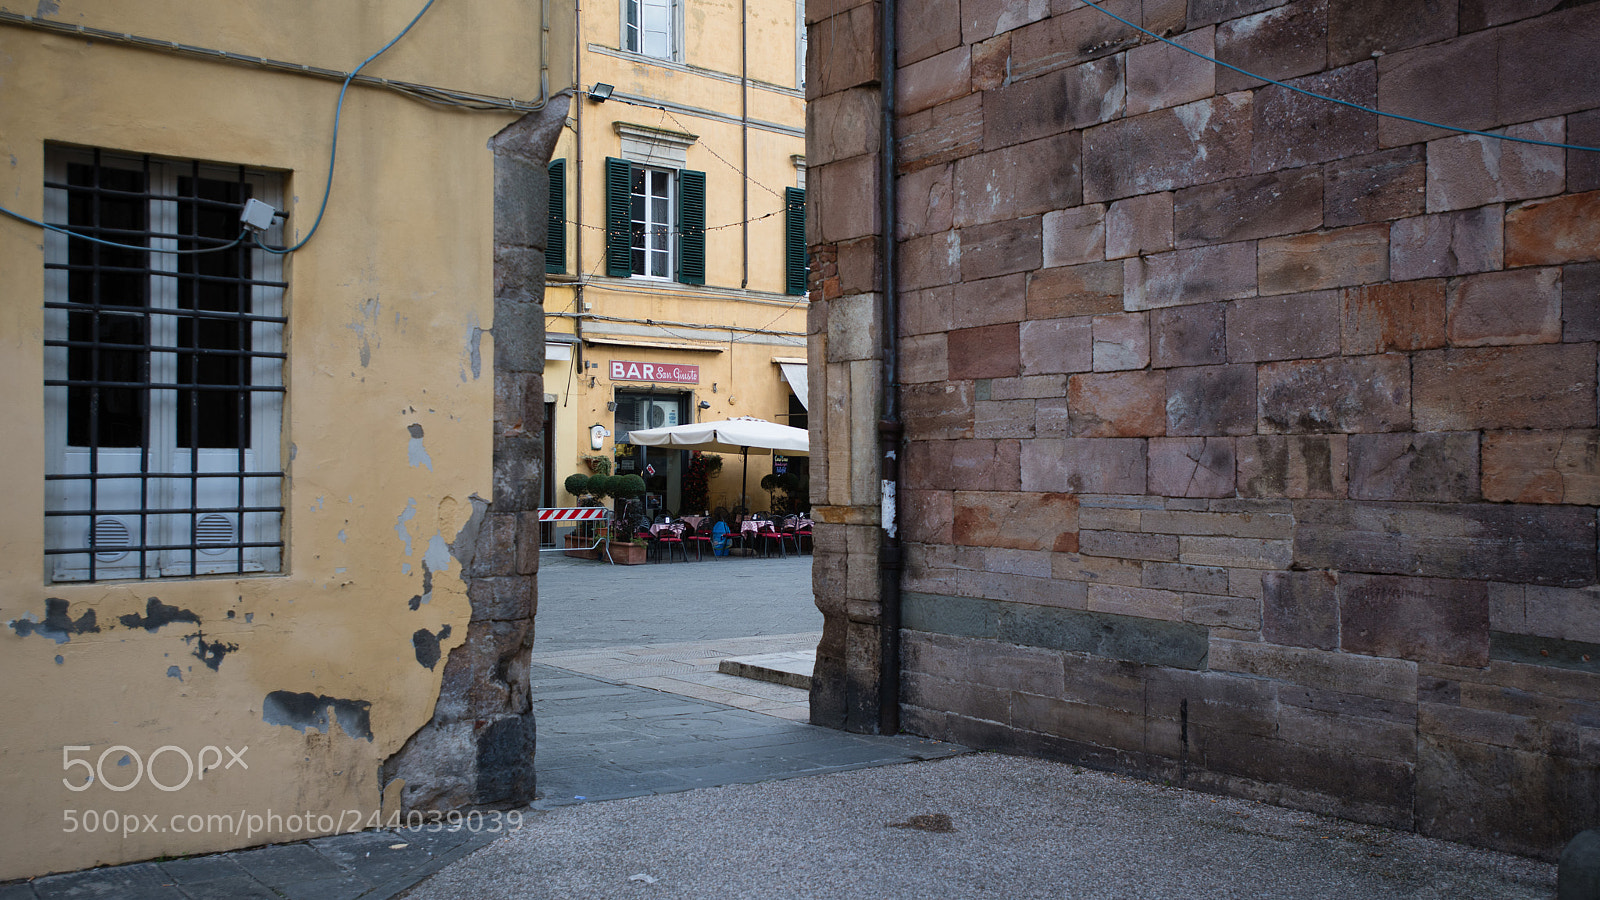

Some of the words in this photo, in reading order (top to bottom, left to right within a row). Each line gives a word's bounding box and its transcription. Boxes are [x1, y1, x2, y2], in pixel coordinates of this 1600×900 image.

[612, 362, 654, 380] BAR
[656, 366, 672, 379] San
[673, 367, 698, 381] Giusto
